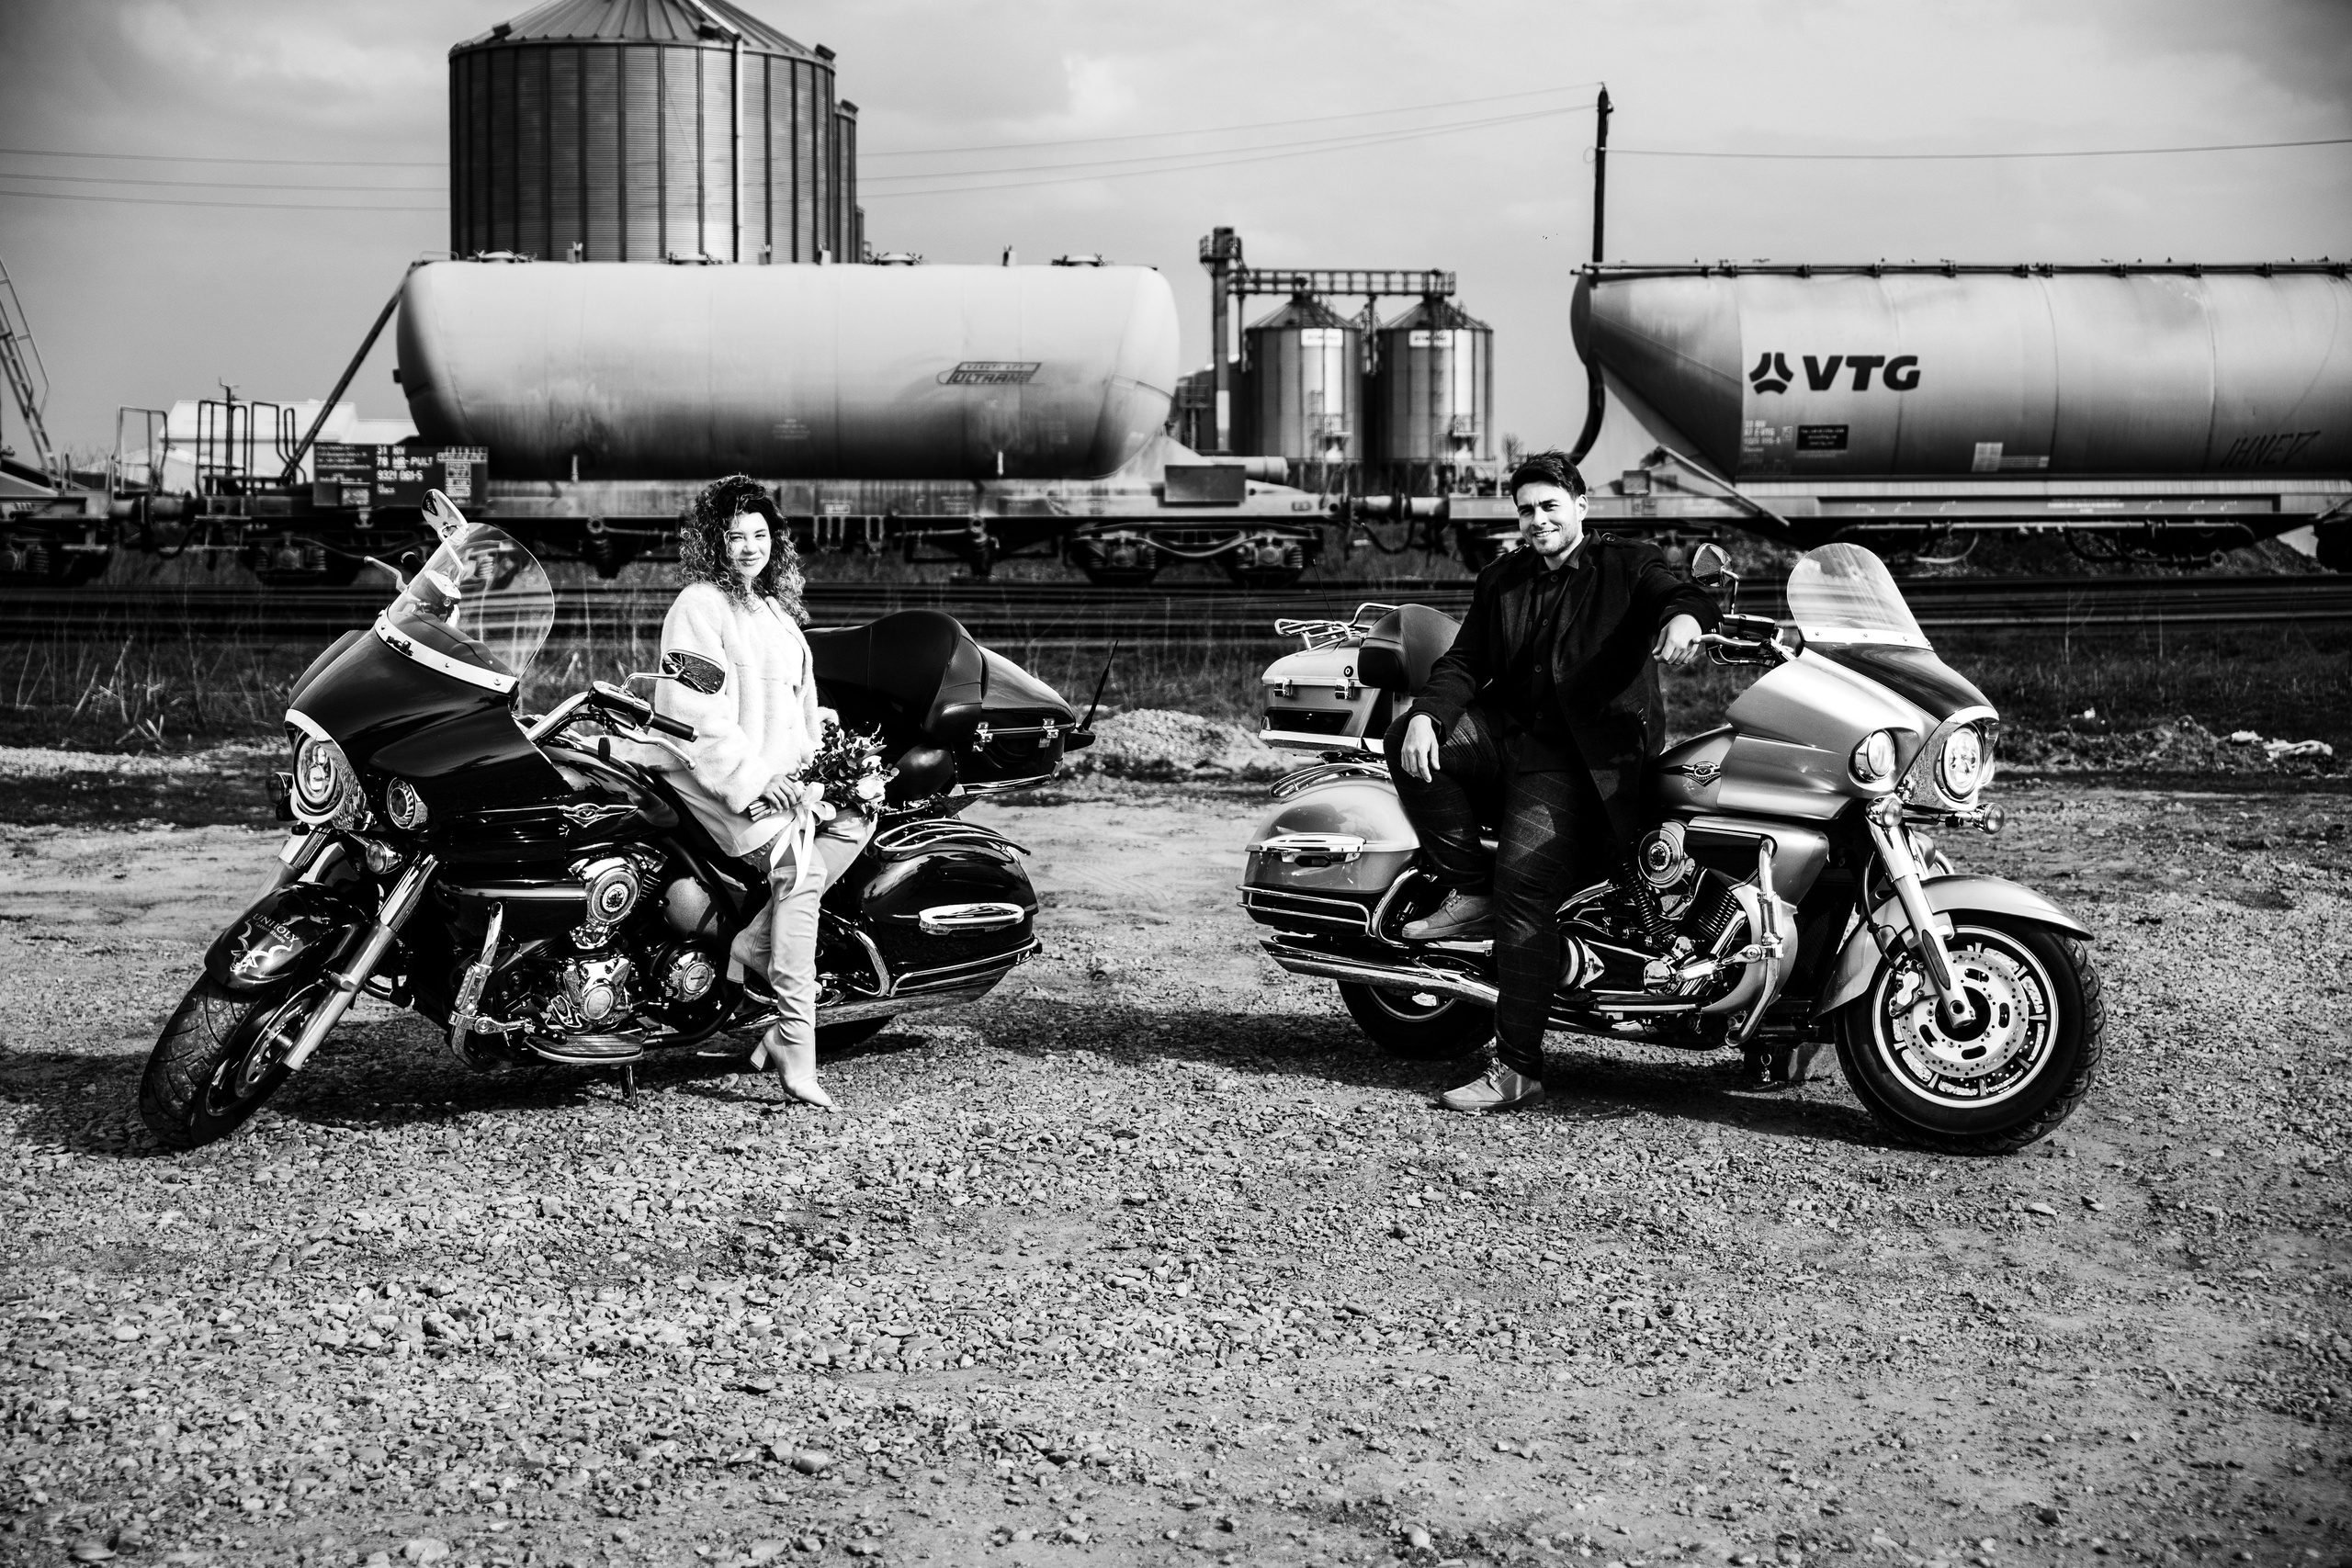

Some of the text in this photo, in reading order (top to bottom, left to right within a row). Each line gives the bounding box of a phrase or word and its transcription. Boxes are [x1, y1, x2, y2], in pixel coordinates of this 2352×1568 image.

[1803, 355, 1921, 391] VTG
[253, 913, 300, 942] UNHOLY
[269, 930, 286, 943] Studio
